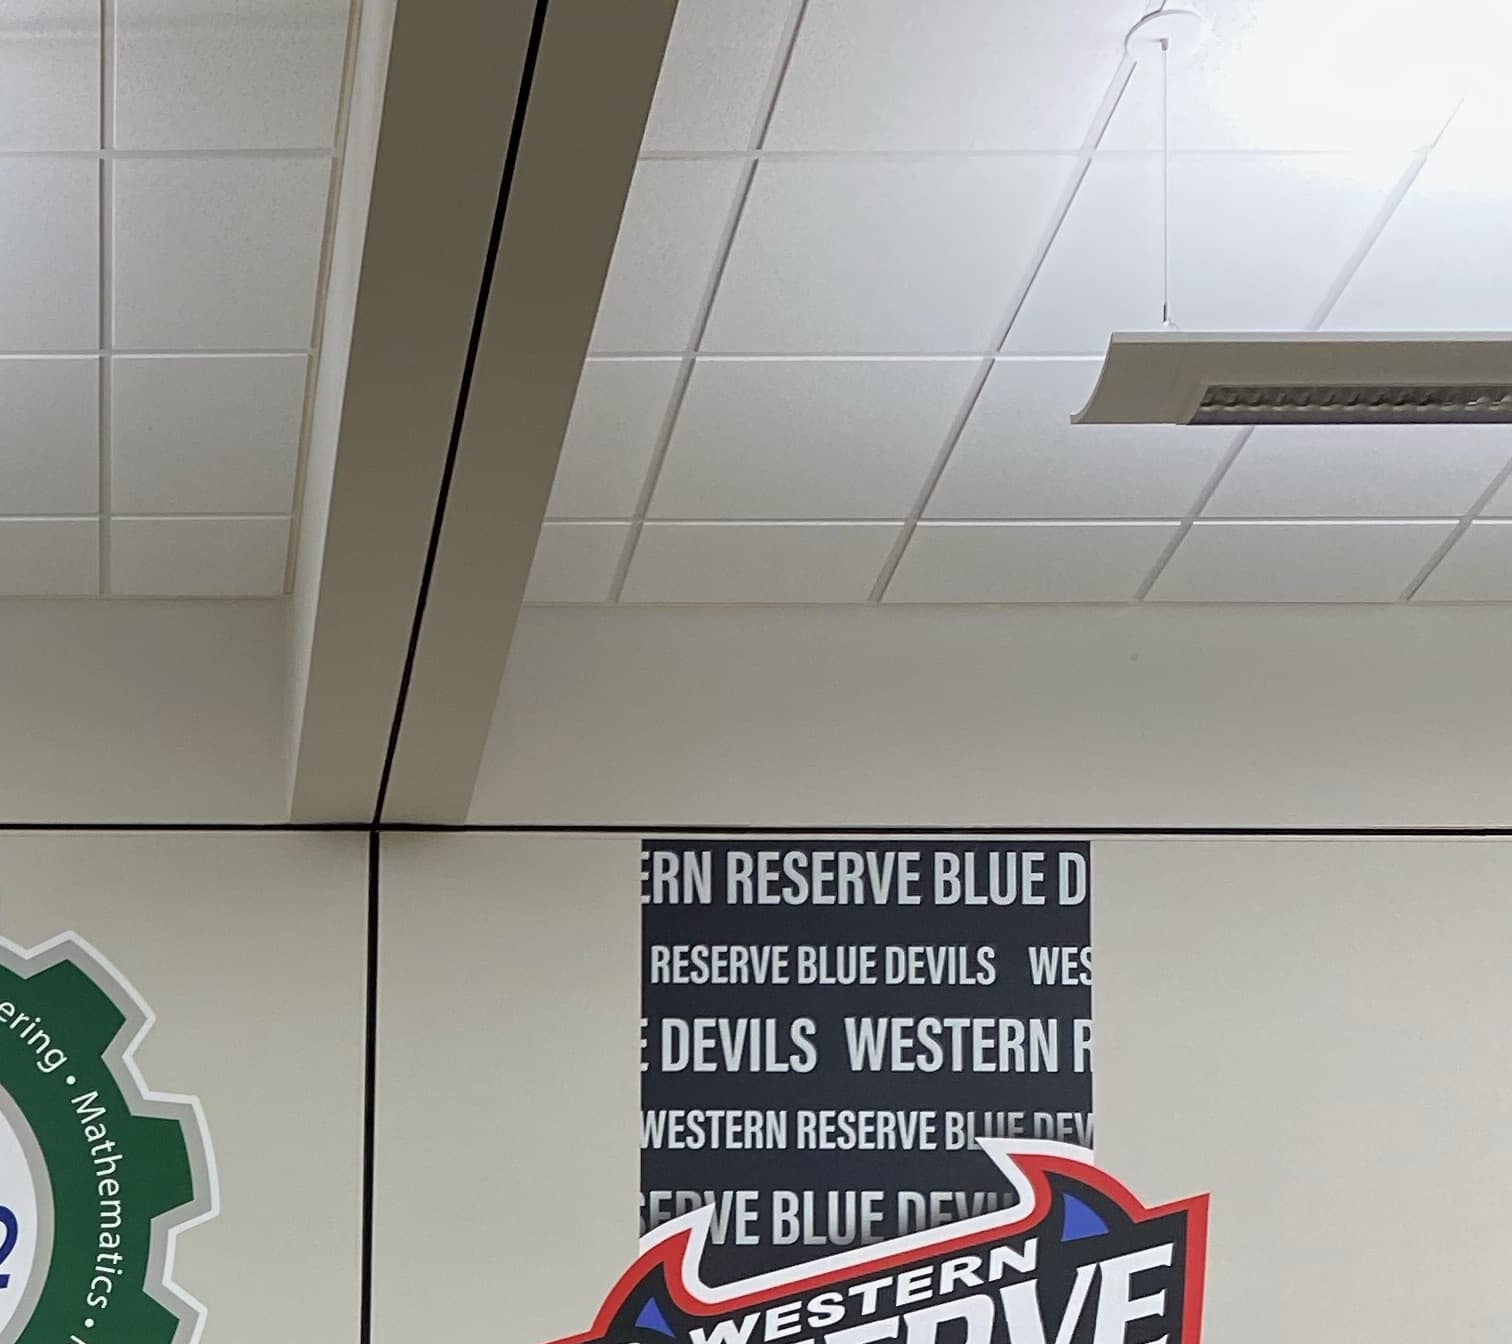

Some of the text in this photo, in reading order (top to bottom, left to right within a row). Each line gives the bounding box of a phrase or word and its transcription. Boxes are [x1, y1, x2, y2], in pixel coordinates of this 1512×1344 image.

[726, 851, 921, 905] RESERVE
[934, 852, 1045, 906] BLUE
[651, 945, 790, 985] RESERVE
[797, 946, 877, 985] BLUE
[885, 946, 996, 986] DEVILS
[661, 1018, 817, 1073] DEVILS
[844, 1017, 1058, 1073] WESTERN
[640, 1110, 786, 1149] WESTERN
[797, 1110, 936, 1150] RESERVE
[72, 1089, 124, 1309] Mathematics
[640, 1190, 760, 1245] EVE
[772, 1190, 885, 1245] BLUE
